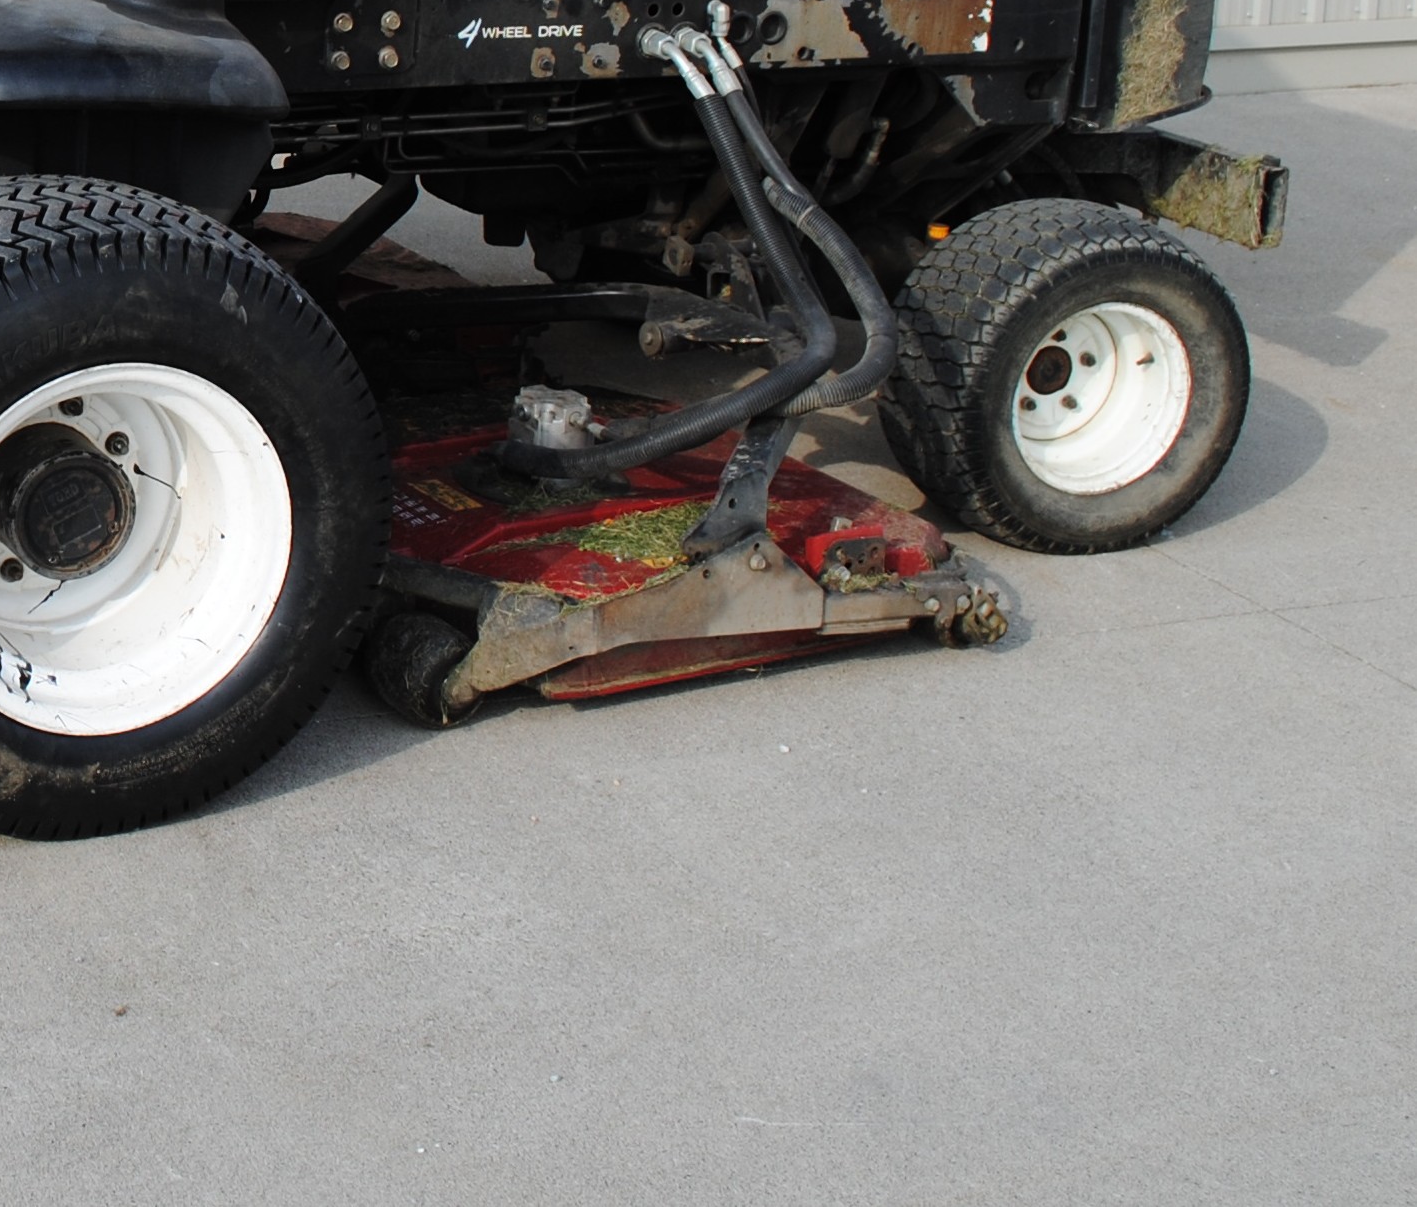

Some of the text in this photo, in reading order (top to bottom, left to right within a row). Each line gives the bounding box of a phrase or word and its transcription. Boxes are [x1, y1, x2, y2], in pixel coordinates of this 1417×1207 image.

[457, 17, 584, 49] 4 WHEEL DRIVE
